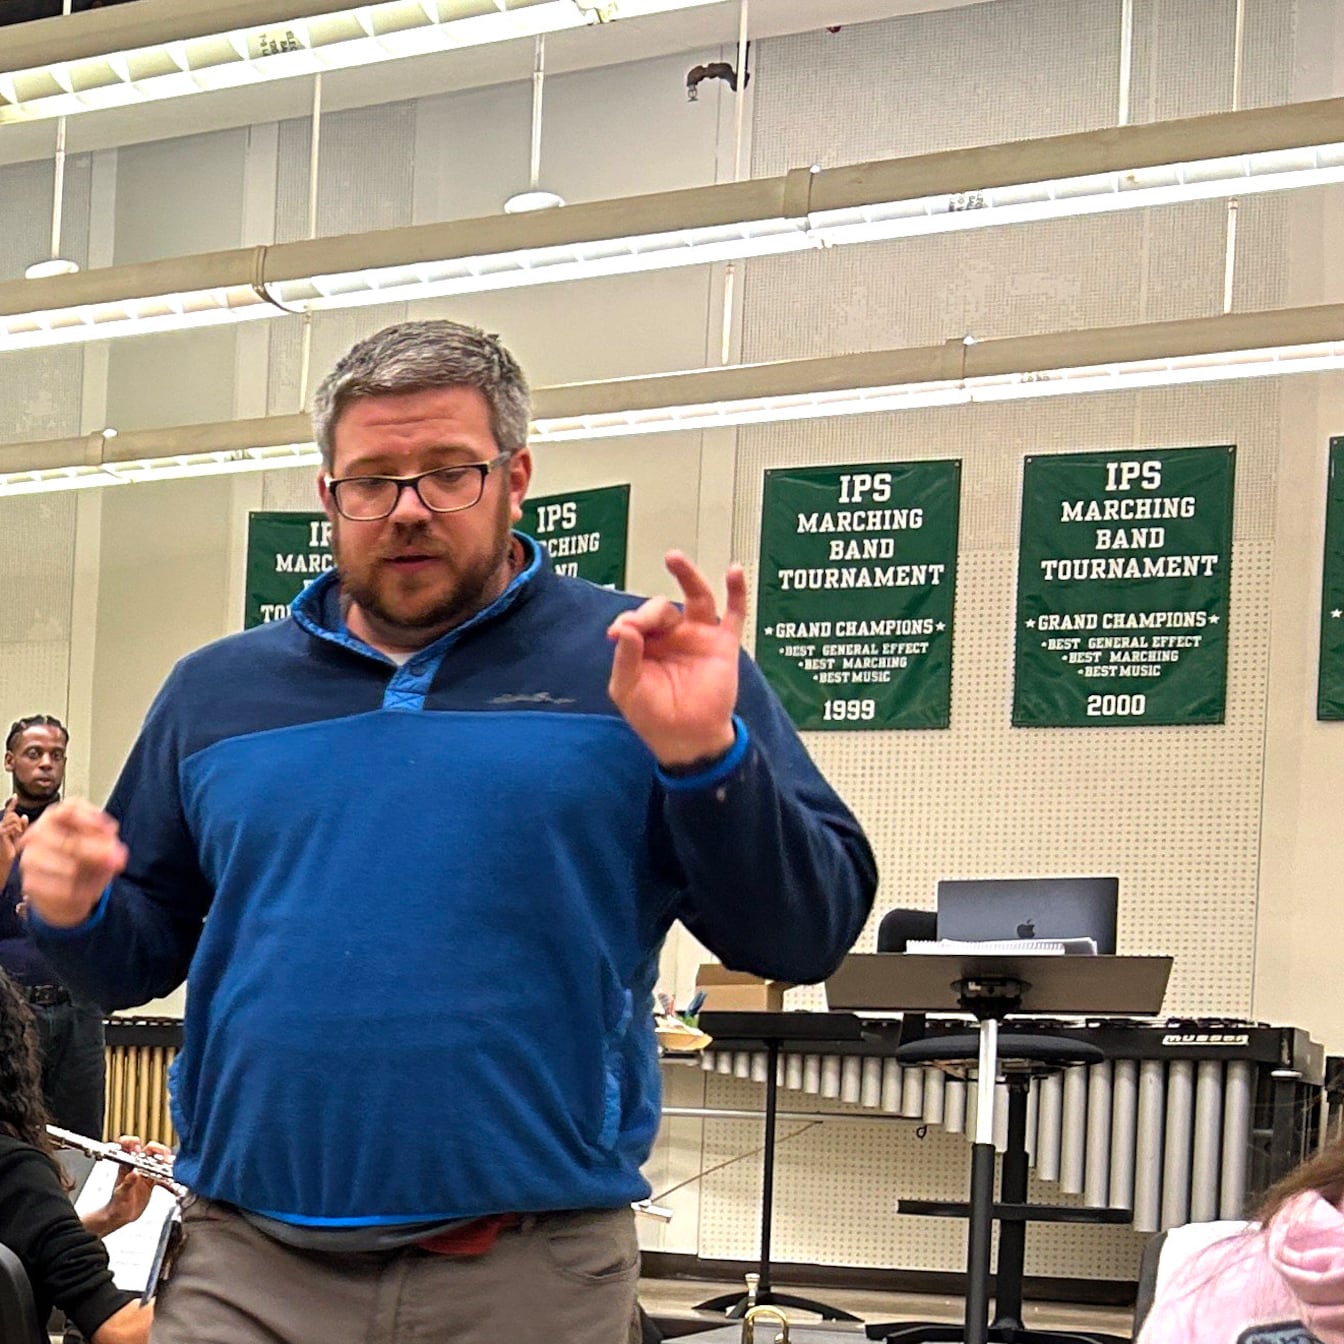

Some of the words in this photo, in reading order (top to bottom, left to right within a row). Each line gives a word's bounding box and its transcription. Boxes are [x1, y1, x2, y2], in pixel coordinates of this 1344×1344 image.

[1105, 460, 1163, 491] IPS
[838, 473, 892, 503] IPS
[536, 502, 577, 533] IPS
[797, 508, 924, 533] MARCHING
[1061, 497, 1196, 522] MARCHING
[309, 521, 333, 547] IP
[540, 532, 600, 558] CHING
[1095, 527, 1165, 550] BAND
[829, 538, 895, 560] BAND
[275, 553, 334, 572] MARC
[1041, 555, 1219, 580] TOURNAMENT
[778, 564, 945, 590] TOURNAMENT
[776, 622, 832, 638] GRAND
[835, 619, 934, 637] CHAMPIONS
[1038, 613, 1098, 631] GRAND
[1102, 611, 1207, 629] CHAMPIONS
[784, 645, 816, 657] BEST
[822, 644, 879, 656] GENERAL
[882, 642, 929, 654] EFFECT
[1047, 638, 1081, 650] BEST
[1088, 637, 1149, 649] GENERAL
[1152, 635, 1202, 648] EFFECT
[804, 658, 835, 670] BEST
[842, 657, 908, 669] MARCHING
[1068, 652, 1102, 663] BEST
[1109, 650, 1179, 662] MARCHING
[819, 672, 850, 683] BEST
[851, 671, 891, 682] MUSIC
[1084, 666, 1117, 677] BEST
[1119, 665, 1161, 677] MUSIC
[823, 699, 876, 720] 1999
[1086, 694, 1146, 716] 2000
